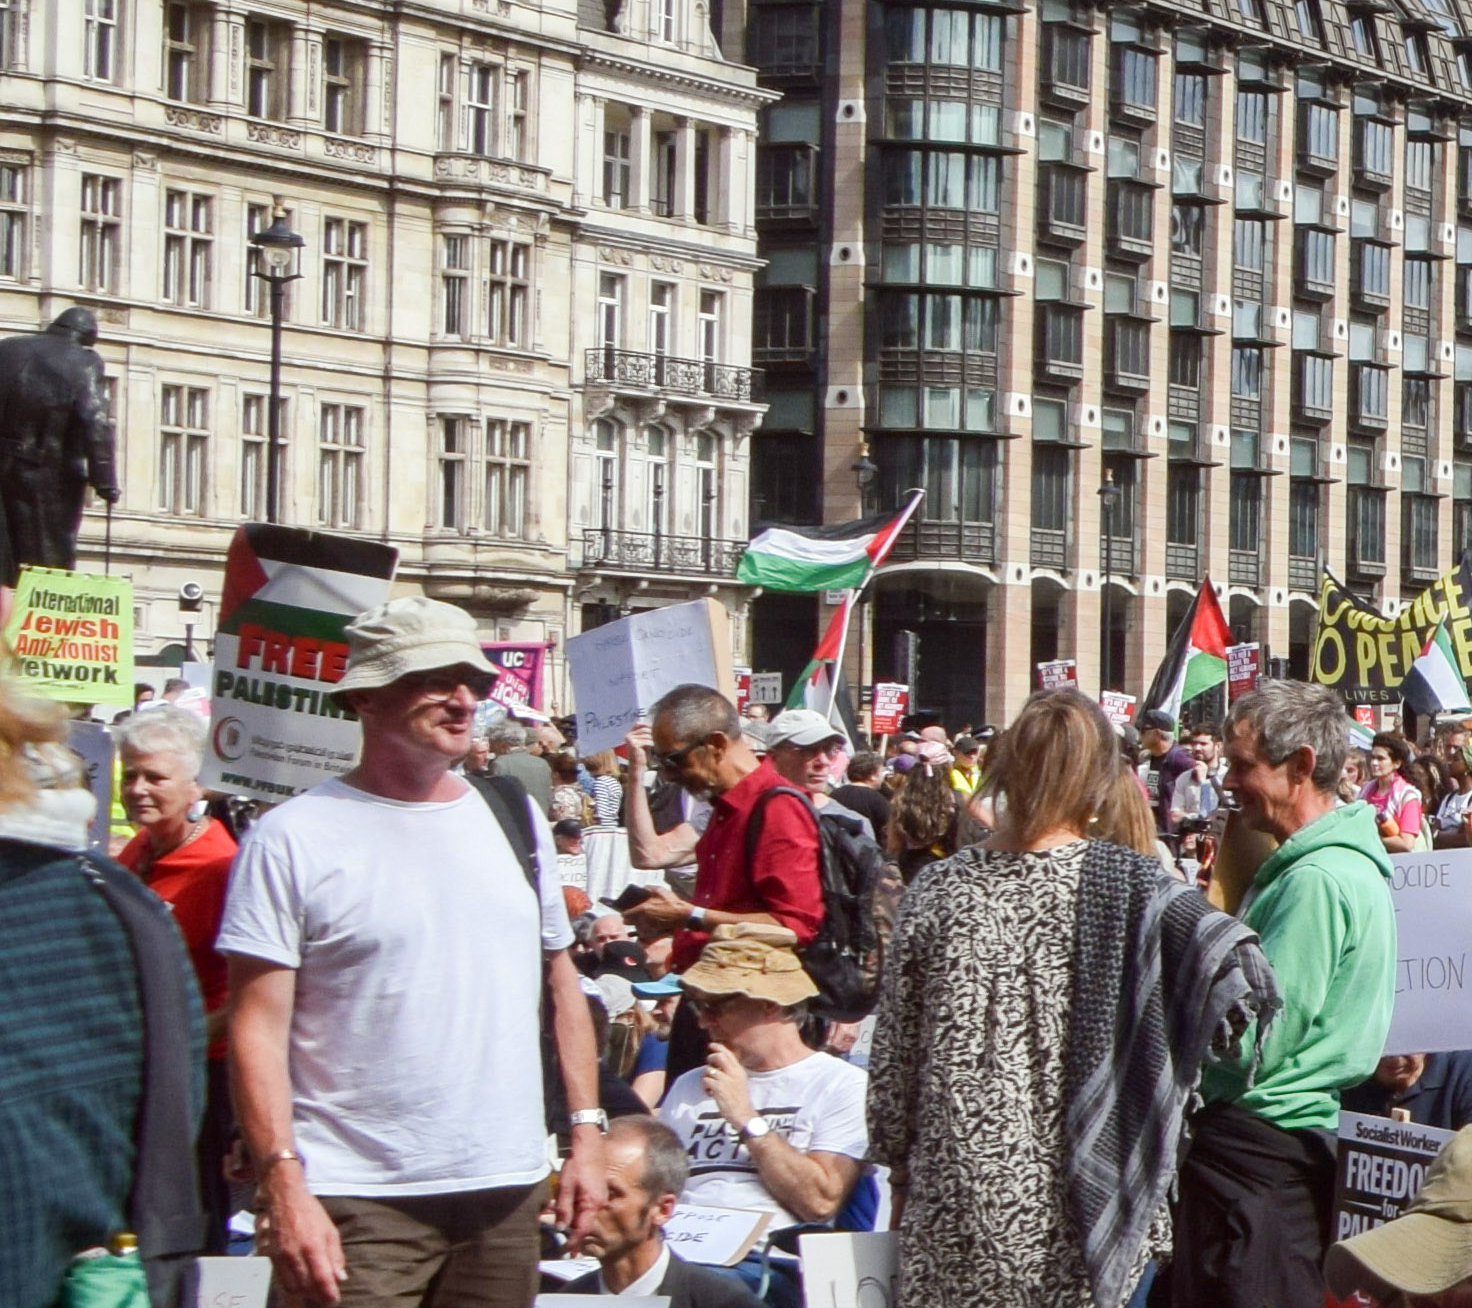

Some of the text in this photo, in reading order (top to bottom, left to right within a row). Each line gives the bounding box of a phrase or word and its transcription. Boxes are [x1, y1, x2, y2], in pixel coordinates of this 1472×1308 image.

[20, 611, 118, 639] Jewish
[237, 623, 350, 683] FREE
[1390, 863, 1451, 891] OCIDE
[1356, 1121, 1442, 1152] Socialist Worker
[1347, 1151, 1428, 1201] FREEDO
[1382, 1198, 1399, 1219] for
